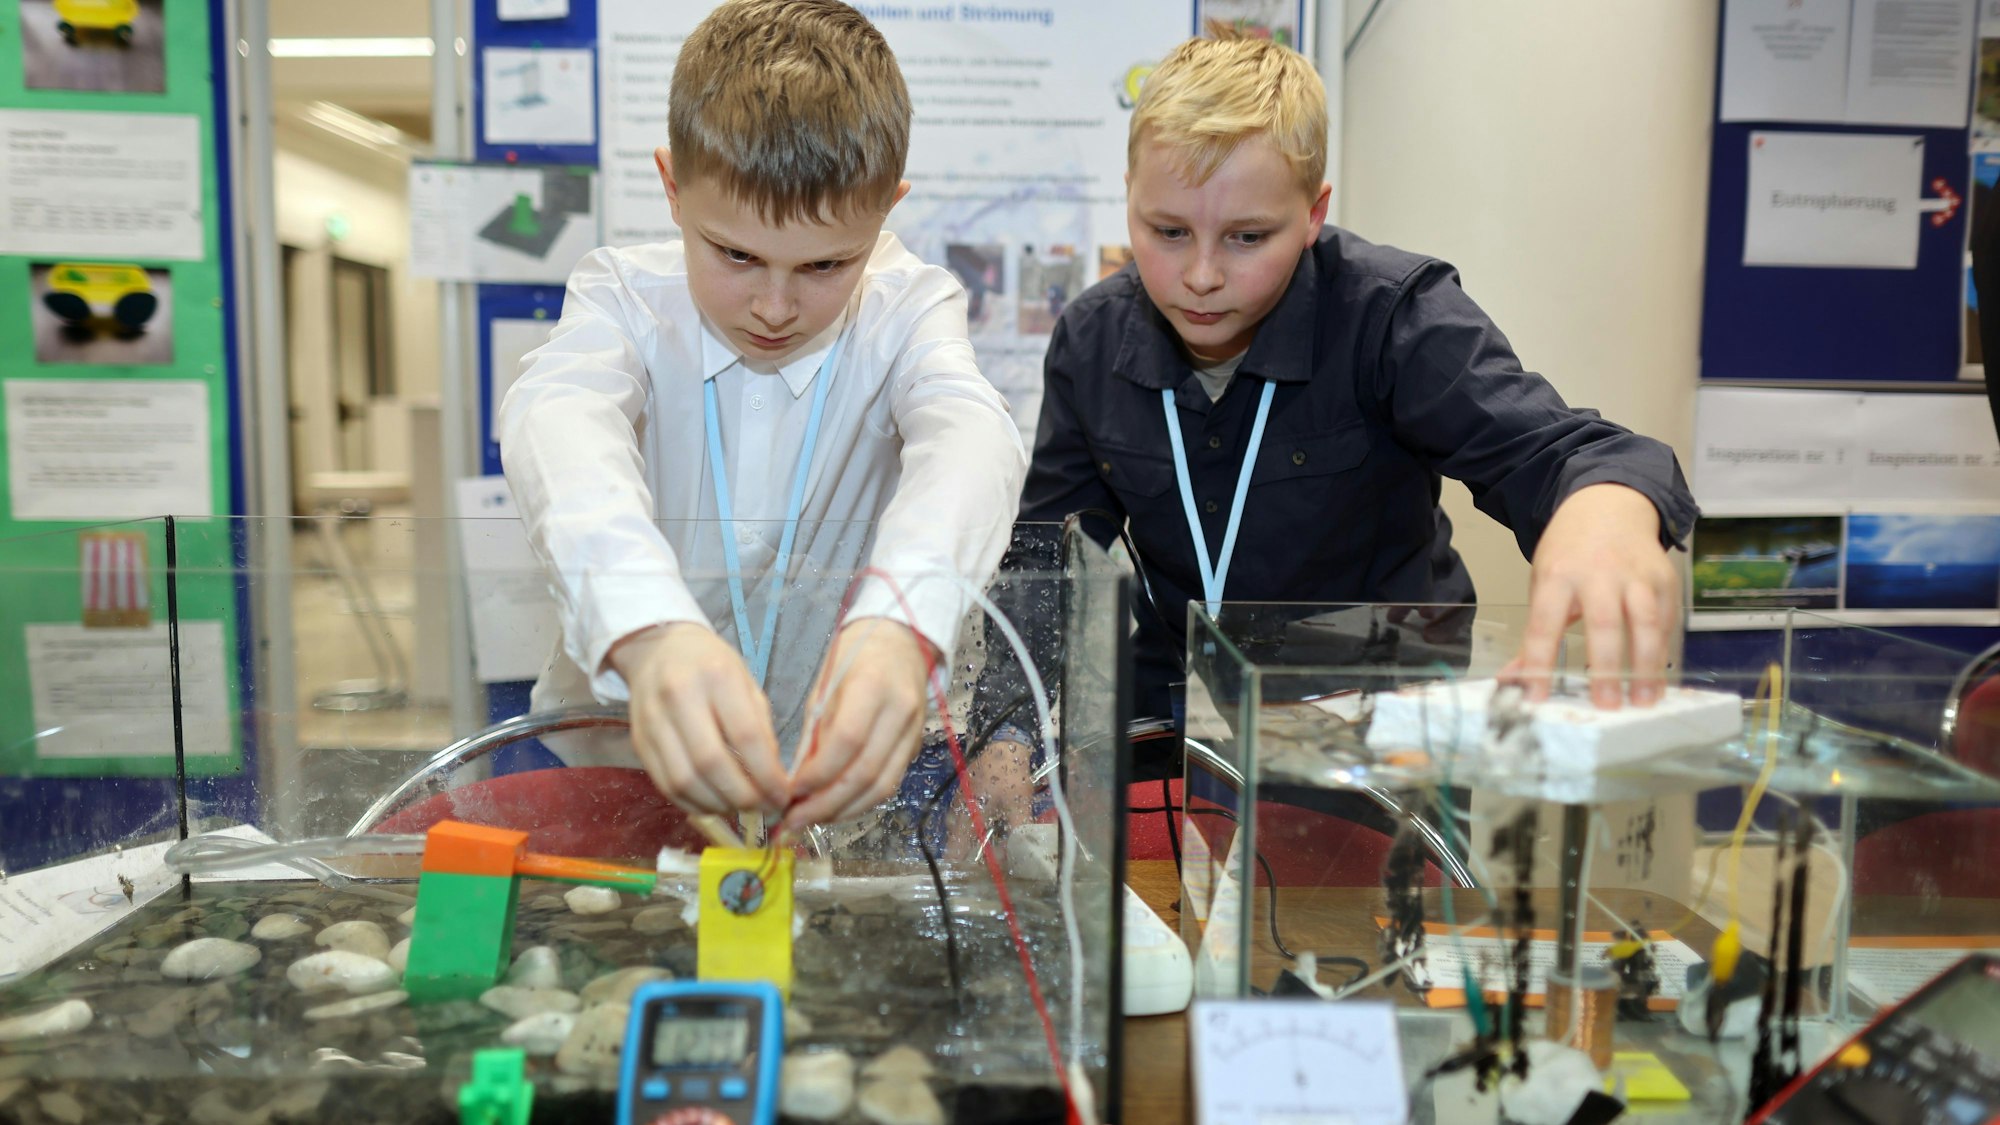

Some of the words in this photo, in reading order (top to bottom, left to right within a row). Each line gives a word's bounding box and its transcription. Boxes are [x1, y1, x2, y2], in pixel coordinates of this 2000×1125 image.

[916, 5, 952, 21] und
[958, 5, 1054, 25] Strömung
[1771, 191, 1897, 215] Eutrophierung
[1867, 450, 1958, 469] Inspiration
